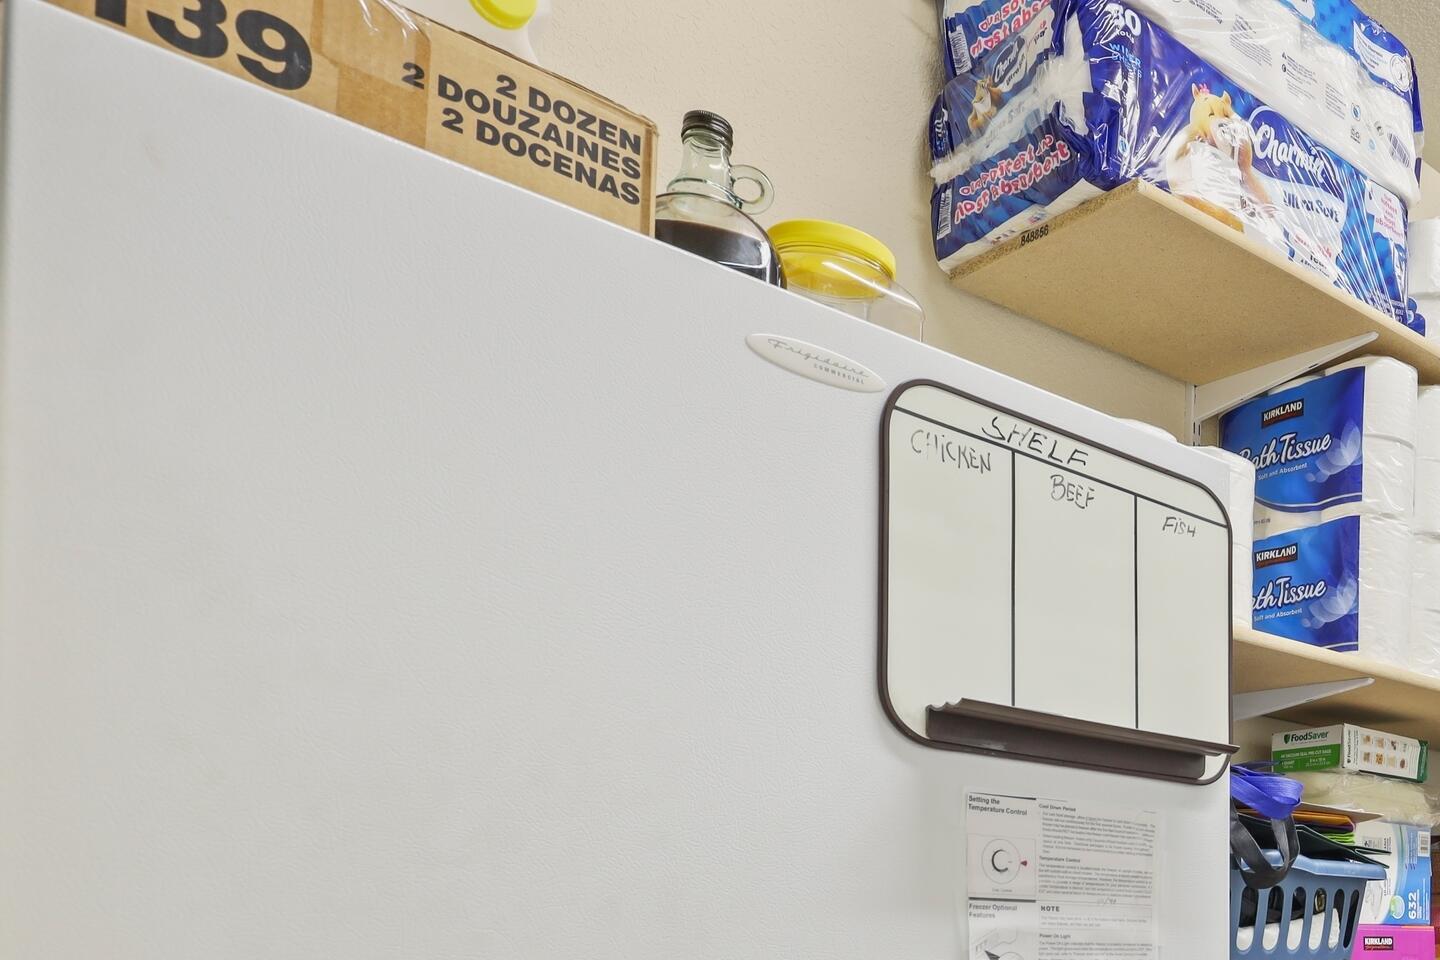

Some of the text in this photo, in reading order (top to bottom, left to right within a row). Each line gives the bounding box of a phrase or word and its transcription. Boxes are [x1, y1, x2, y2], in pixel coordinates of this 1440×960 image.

[401, 62, 641, 180] 2 DOUZAINES
[496, 74, 641, 156] 2 DOZEN
[441, 107, 640, 205] 2 DOCENAS
[1256, 122, 1326, 184] Charmin
[813, 363, 865, 384] COMMERCIAL
[1263, 400, 1303, 422] KIRKLAND
[981, 415, 1089, 467] SHELF
[1280, 433, 1332, 464] Tissue
[1050, 474, 1095, 510] BEEF
[1256, 545, 1297, 562] KIRKLAND
[1253, 576, 1327, 610] ath Tissue
[1290, 731, 1329, 742] FoodSaver
[968, 795, 990, 805] Setting
[968, 804, 1028, 816] Temperature Control
[968, 903, 1018, 913] Freezer Optional
[1408, 892, 1417, 919] 632
[1364, 937, 1393, 946] KIRKLAND
